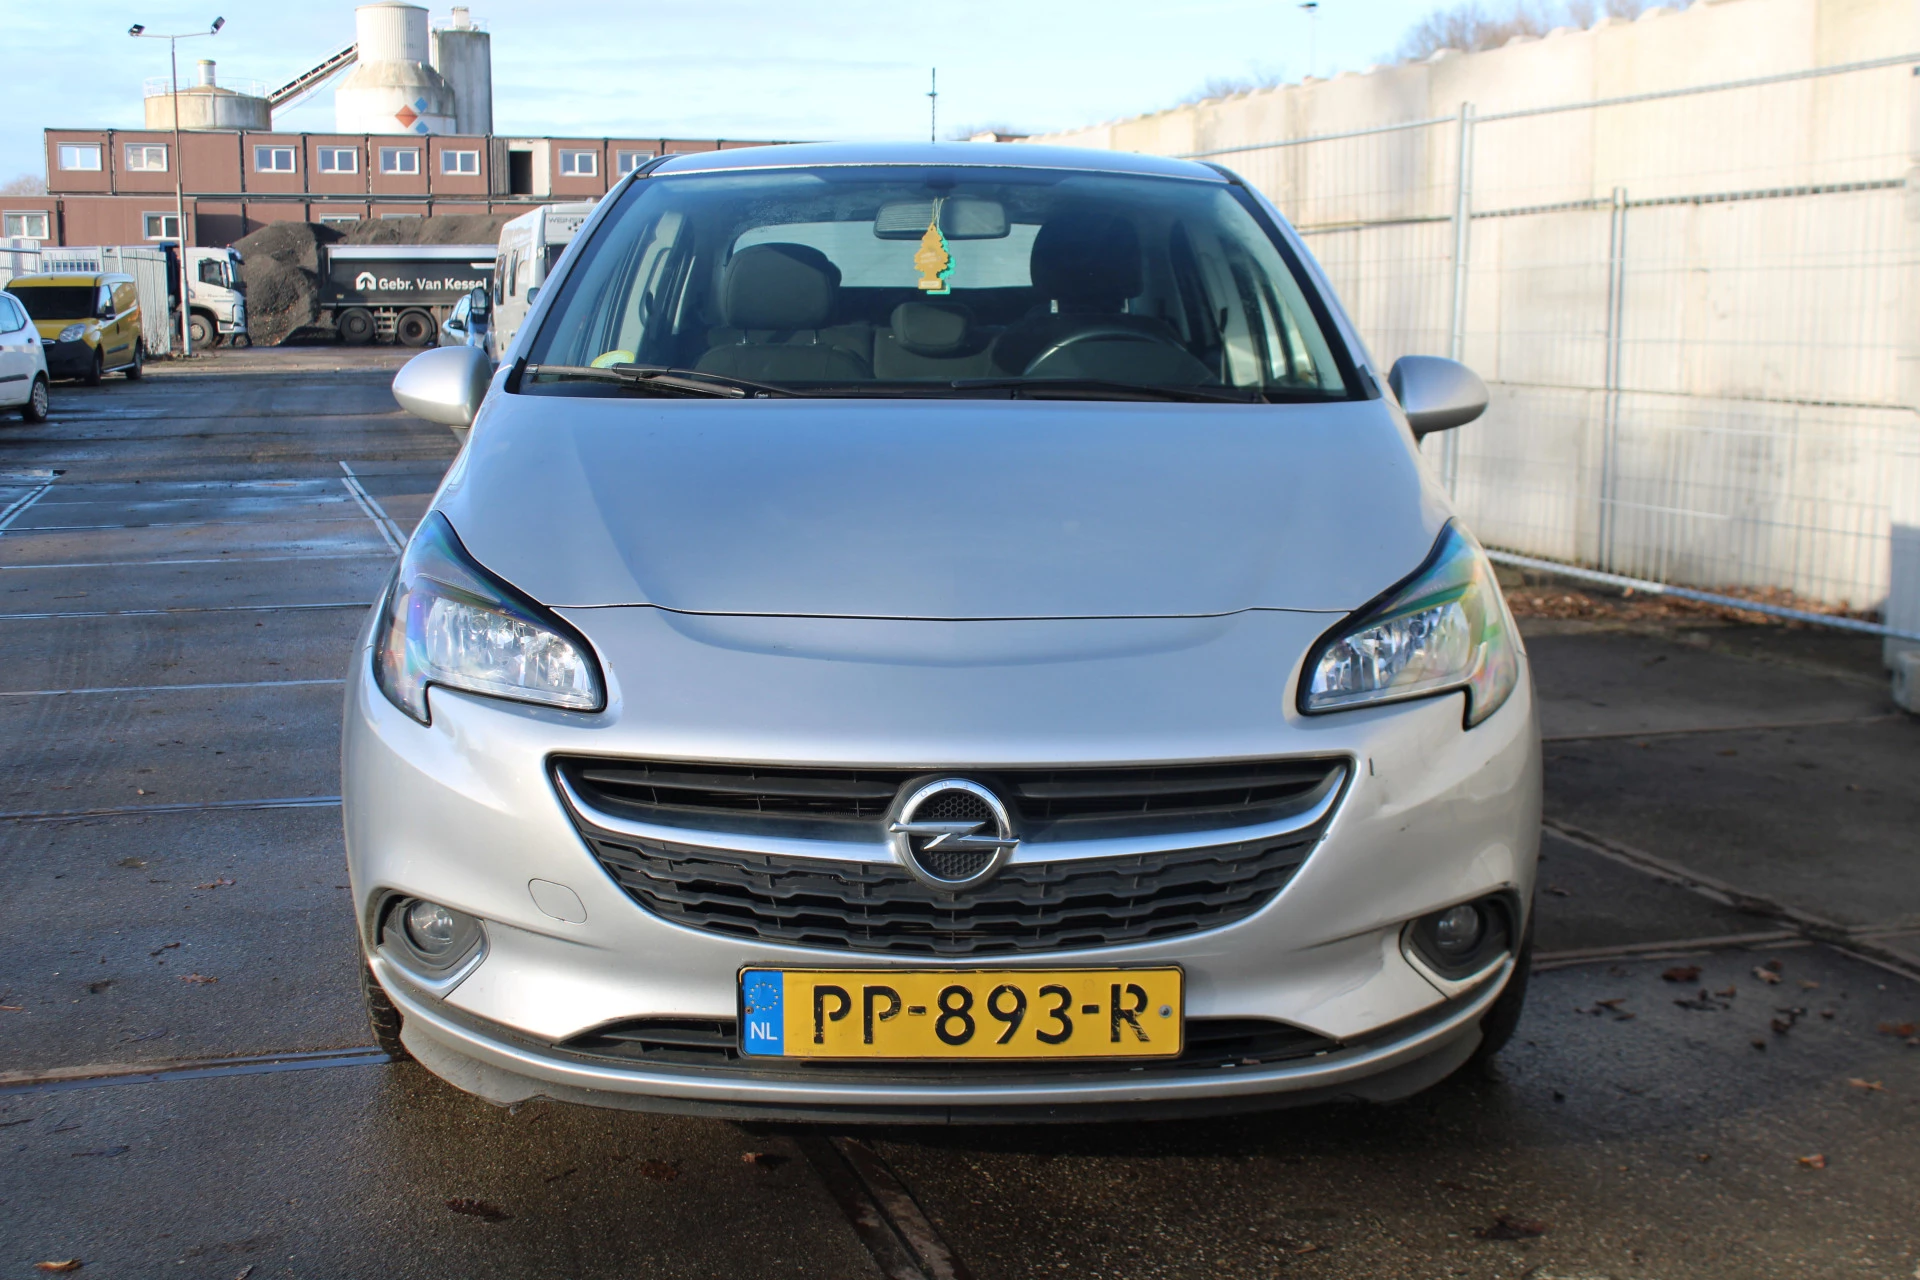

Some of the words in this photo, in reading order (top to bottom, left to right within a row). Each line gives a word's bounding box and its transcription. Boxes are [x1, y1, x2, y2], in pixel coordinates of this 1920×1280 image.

[379, 277, 414, 291] Gebr.
[416, 277, 442, 291] Van
[444, 277, 488, 291] Kessel
[813, 983, 1151, 1046] PP-893-R
[750, 1021, 778, 1041] NL
